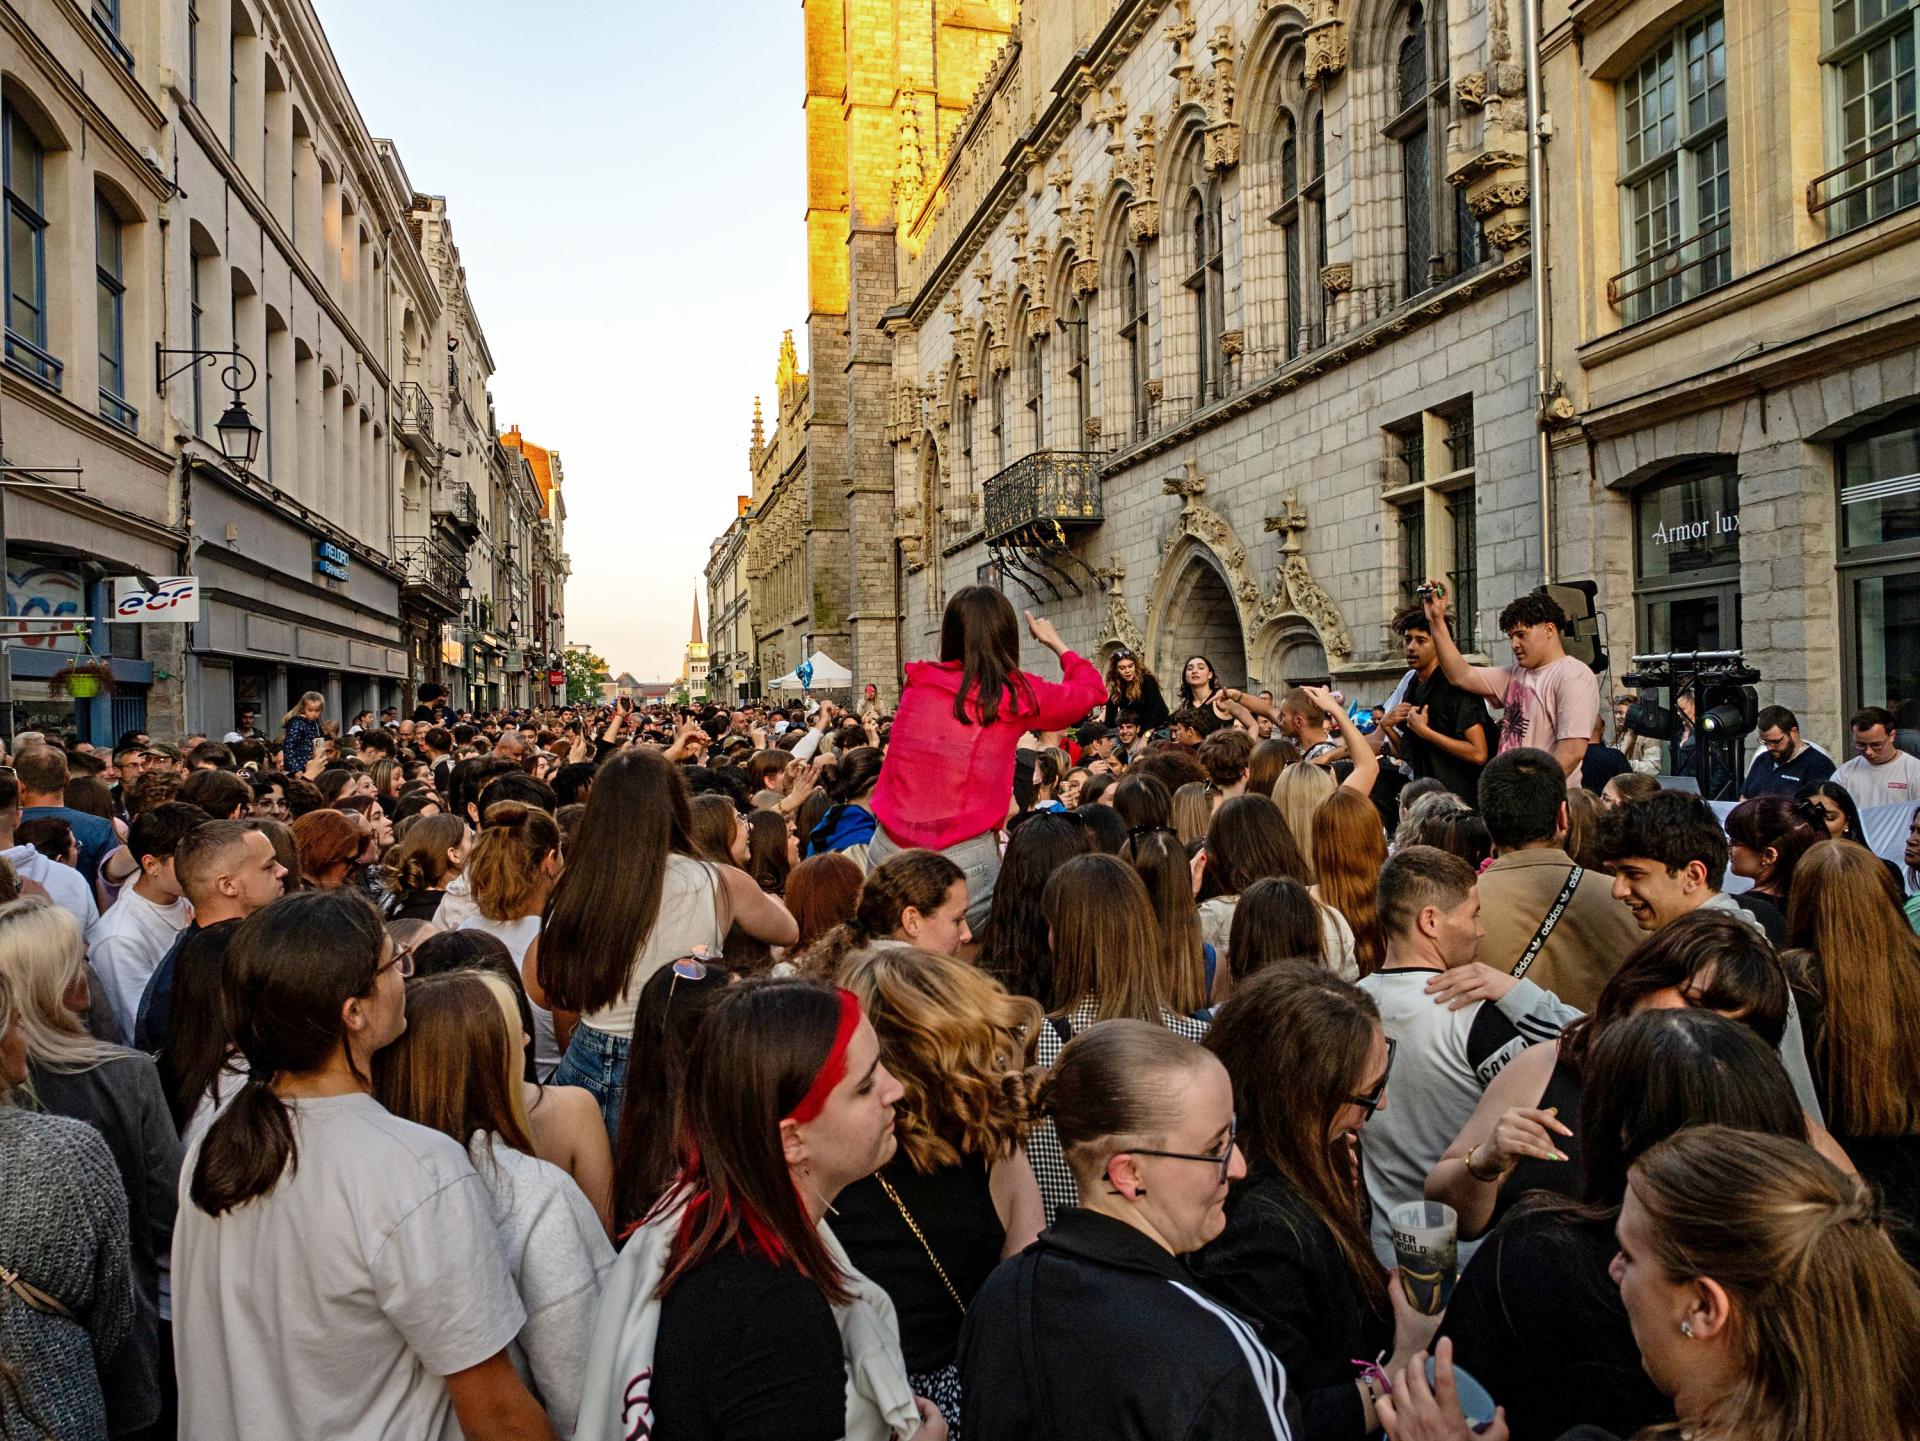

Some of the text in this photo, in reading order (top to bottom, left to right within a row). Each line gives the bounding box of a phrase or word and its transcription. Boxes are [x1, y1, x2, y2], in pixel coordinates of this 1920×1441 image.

[1652, 520, 1710, 545] Armor
[1541, 904, 1564, 936] adidas
[1514, 952, 1535, 978] didas
